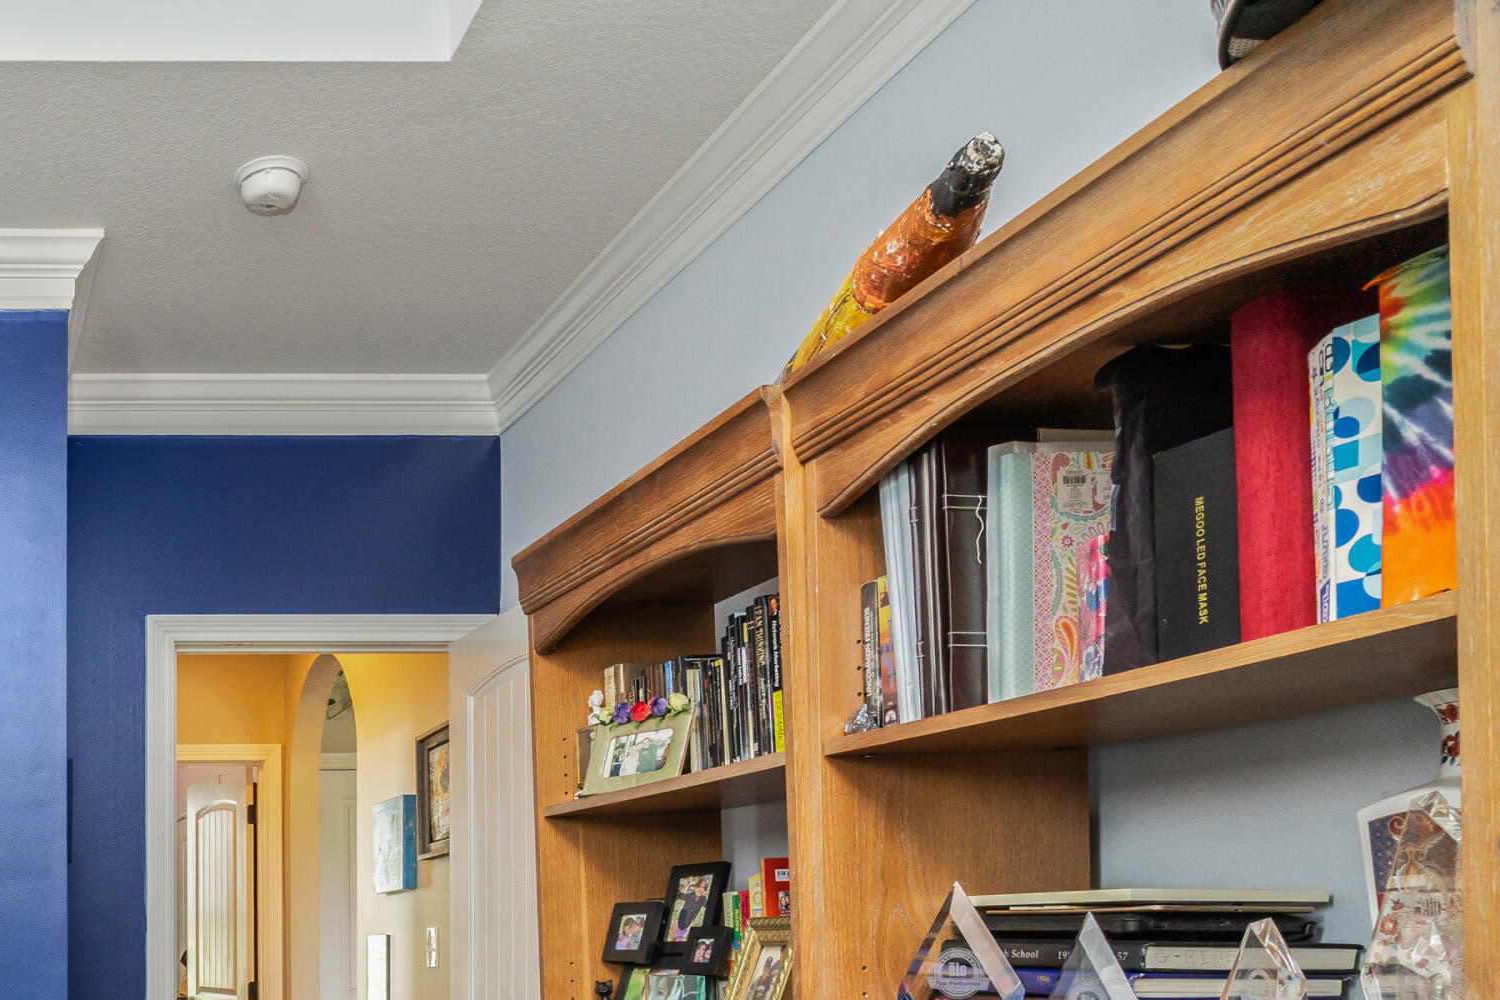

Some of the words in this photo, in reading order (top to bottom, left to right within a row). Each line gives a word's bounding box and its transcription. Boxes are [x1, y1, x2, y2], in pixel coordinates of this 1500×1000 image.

[1194, 496, 1205, 537] MEGOO
[1196, 539, 1206, 560] LED
[1197, 562, 1207, 591] FACE
[754, 605, 764, 627] LEAN
[1197, 593, 1209, 625] MASK
[755, 628, 765, 667] THINKING
[772, 651, 781, 687] Marketing
[1011, 949, 1039, 959] School
